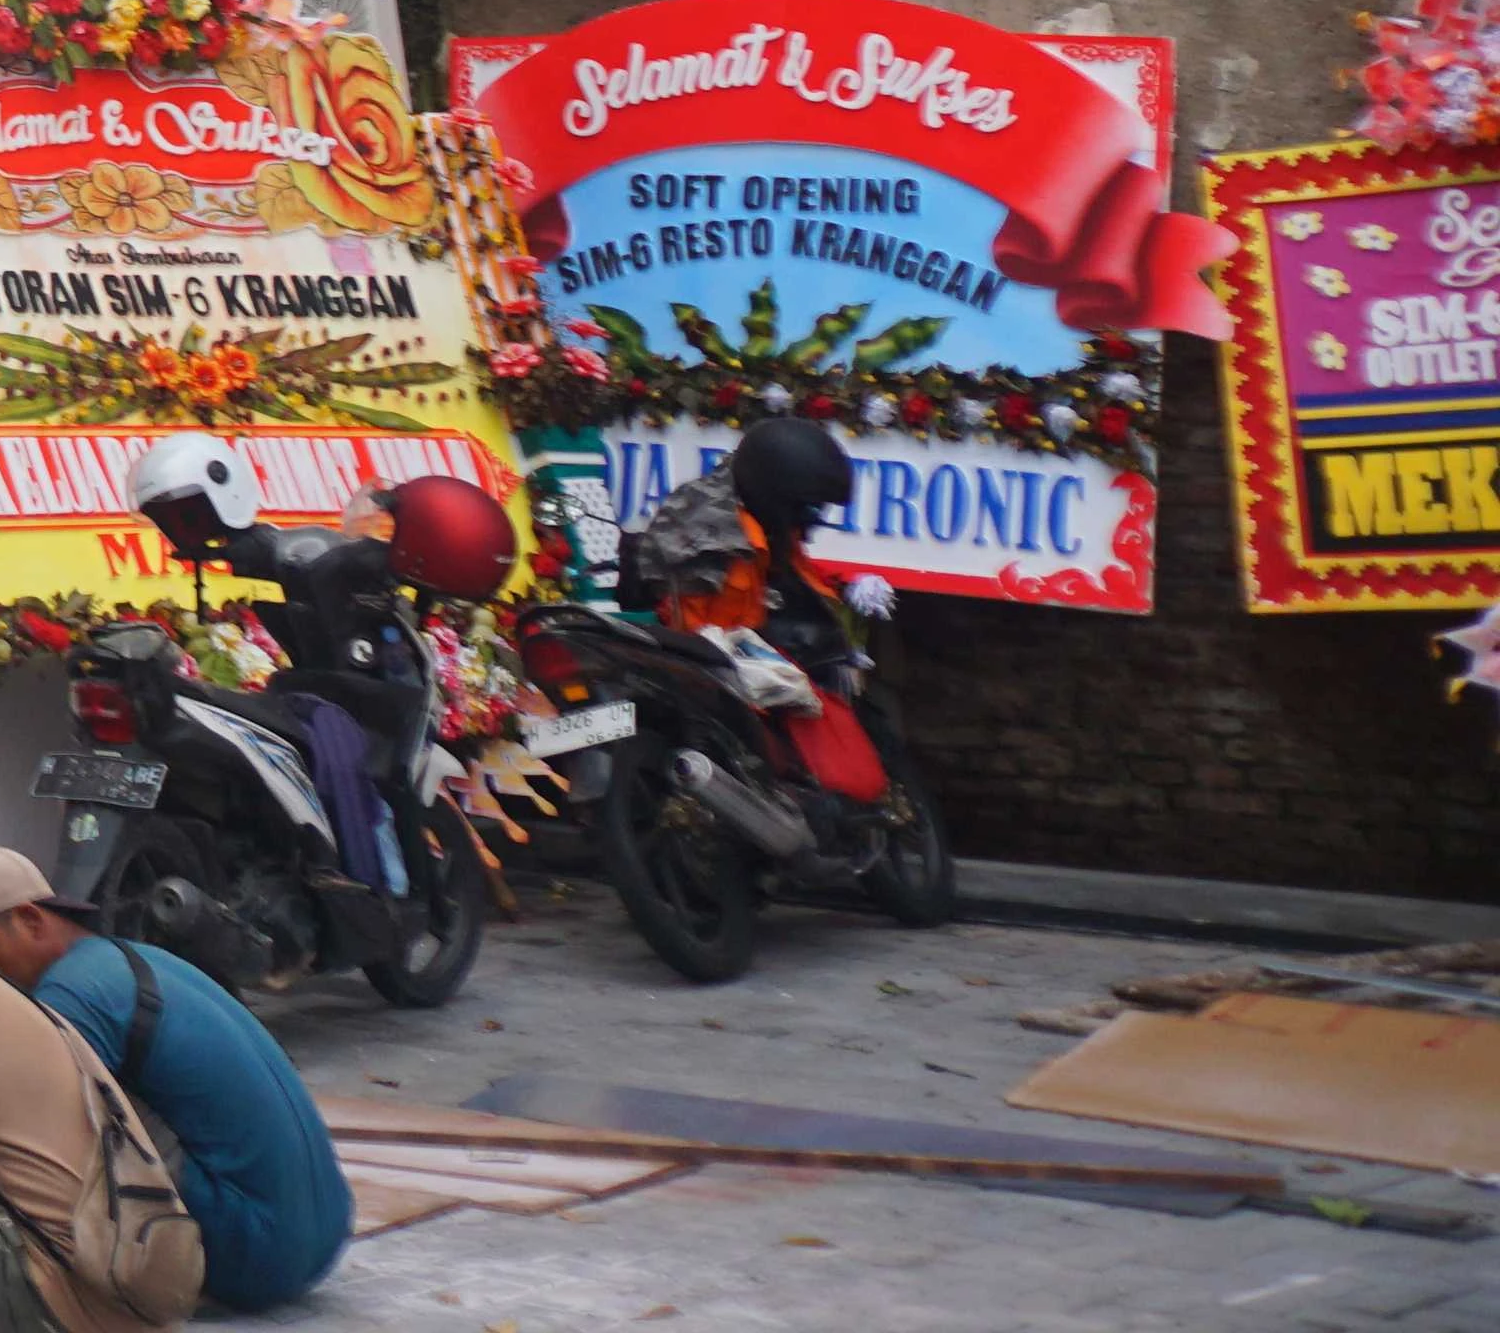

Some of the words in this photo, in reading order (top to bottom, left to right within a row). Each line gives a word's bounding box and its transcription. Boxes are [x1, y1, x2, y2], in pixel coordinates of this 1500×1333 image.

[563, 23, 785, 136] Selamat
[826, 32, 1019, 133] Sukses
[145, 100, 338, 167] Sukses
[629, 173, 726, 210] SOFT
[743, 175, 921, 215] OPENING
[556, 232, 653, 295] SIM-6
[659, 217, 774, 264] RESTO
[790, 217, 1007, 314] KRANGGAN
[216, 273, 420, 321] KRANGGAN
[1365, 340, 1497, 389] OUTLET
